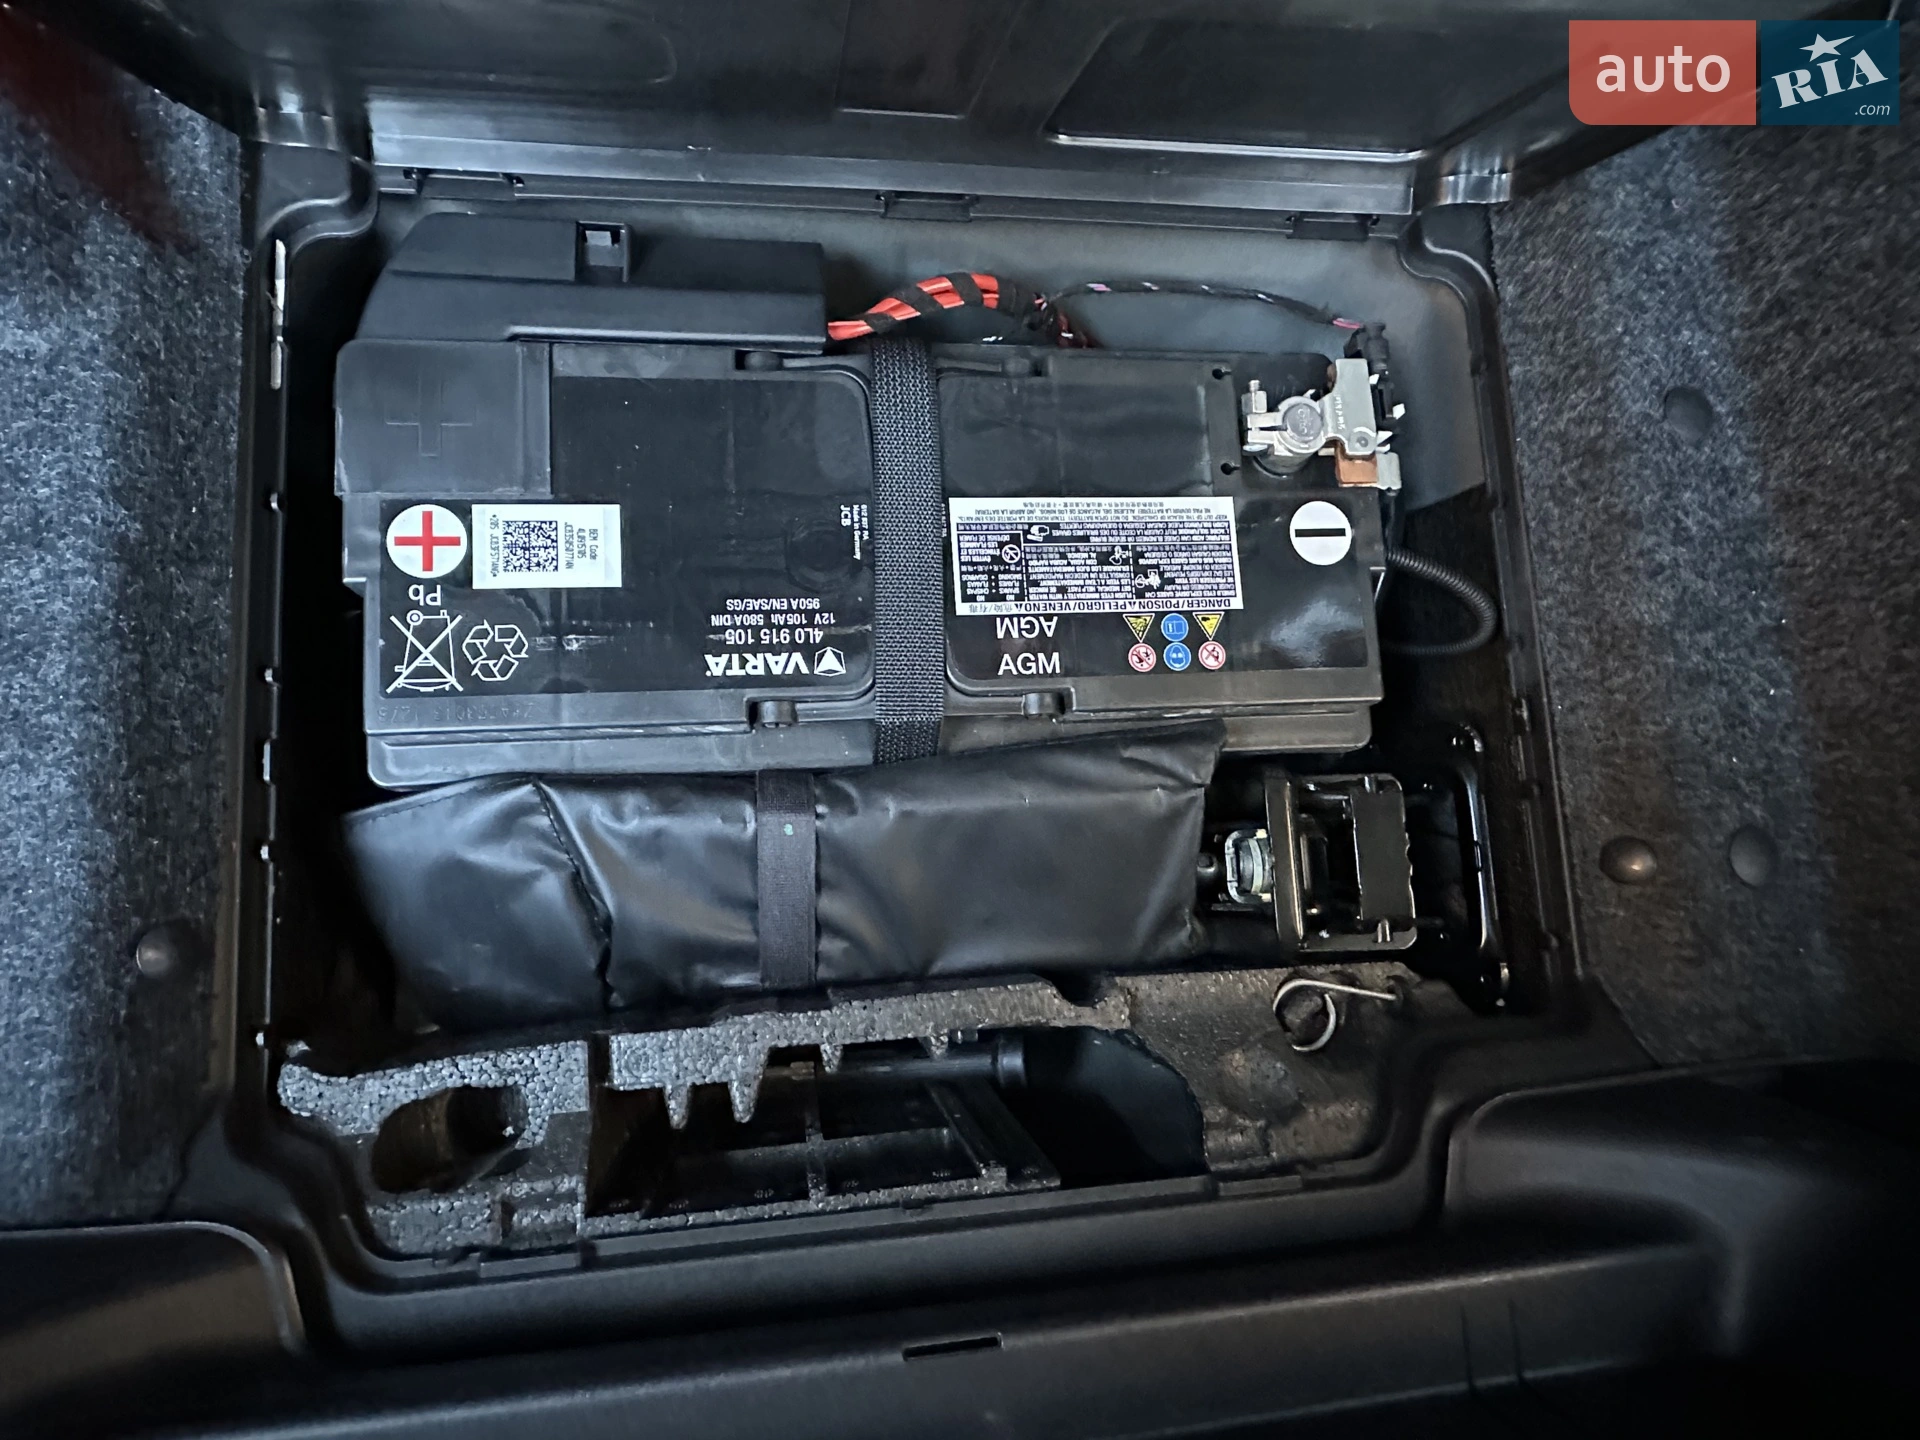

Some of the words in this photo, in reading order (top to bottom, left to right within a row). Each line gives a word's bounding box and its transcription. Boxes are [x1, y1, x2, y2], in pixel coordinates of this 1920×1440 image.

[840, 504, 852, 527] JCB
[852, 504, 860, 522] Made
[853, 522, 860, 530] in
[588, 528, 598, 541] BEM
[589, 544, 598, 560] Code
[853, 530, 861, 560] Germany
[408, 584, 442, 606] Pb
[726, 598, 788, 611] EN/SAE/GS
[790, 598, 820, 610] 950A
[1025, 601, 1126, 612] PELIGRO/VENENO
[1138, 599, 1230, 609] DANGER/POISON
[710, 614, 731, 626] DIN
[734, 614, 764, 626] 580A
[770, 613, 808, 626] 105Ah
[814, 612, 836, 625] 12V
[794, 627, 824, 644] 4L0
[996, 616, 1058, 639] AGM
[725, 628, 754, 645] 105
[760, 628, 790, 644] 915
[704, 652, 810, 677] VARTA
[997, 652, 1060, 676] AGM
